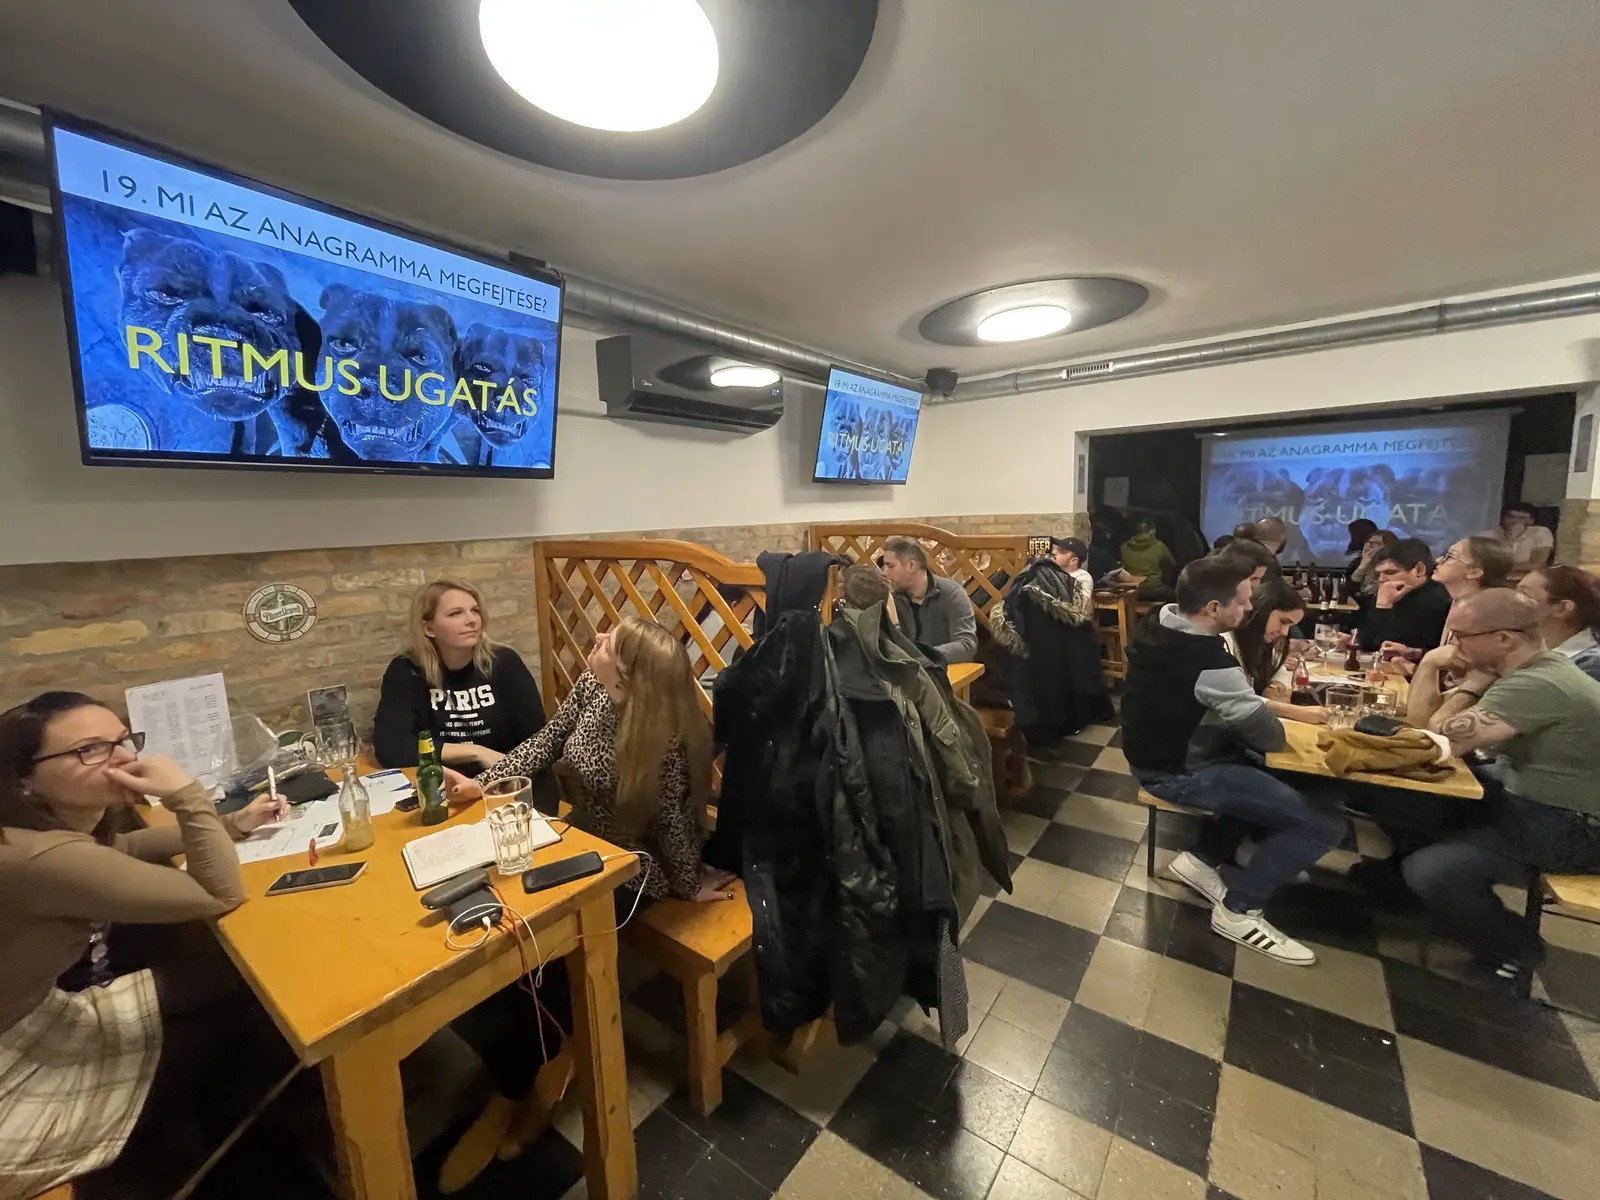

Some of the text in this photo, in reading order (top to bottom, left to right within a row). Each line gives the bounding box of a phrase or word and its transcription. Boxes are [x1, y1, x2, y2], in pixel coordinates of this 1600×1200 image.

[102, 169, 548, 313] 19. MI AZ ANAGRAMMA MEGFEJTÉSE?
[125, 324, 539, 418] RITMUS UGATÁS
[1280, 442, 1379, 456] ANAGRAMMA
[1029, 541, 1050, 550] BEER
[429, 684, 496, 711] PARIS
